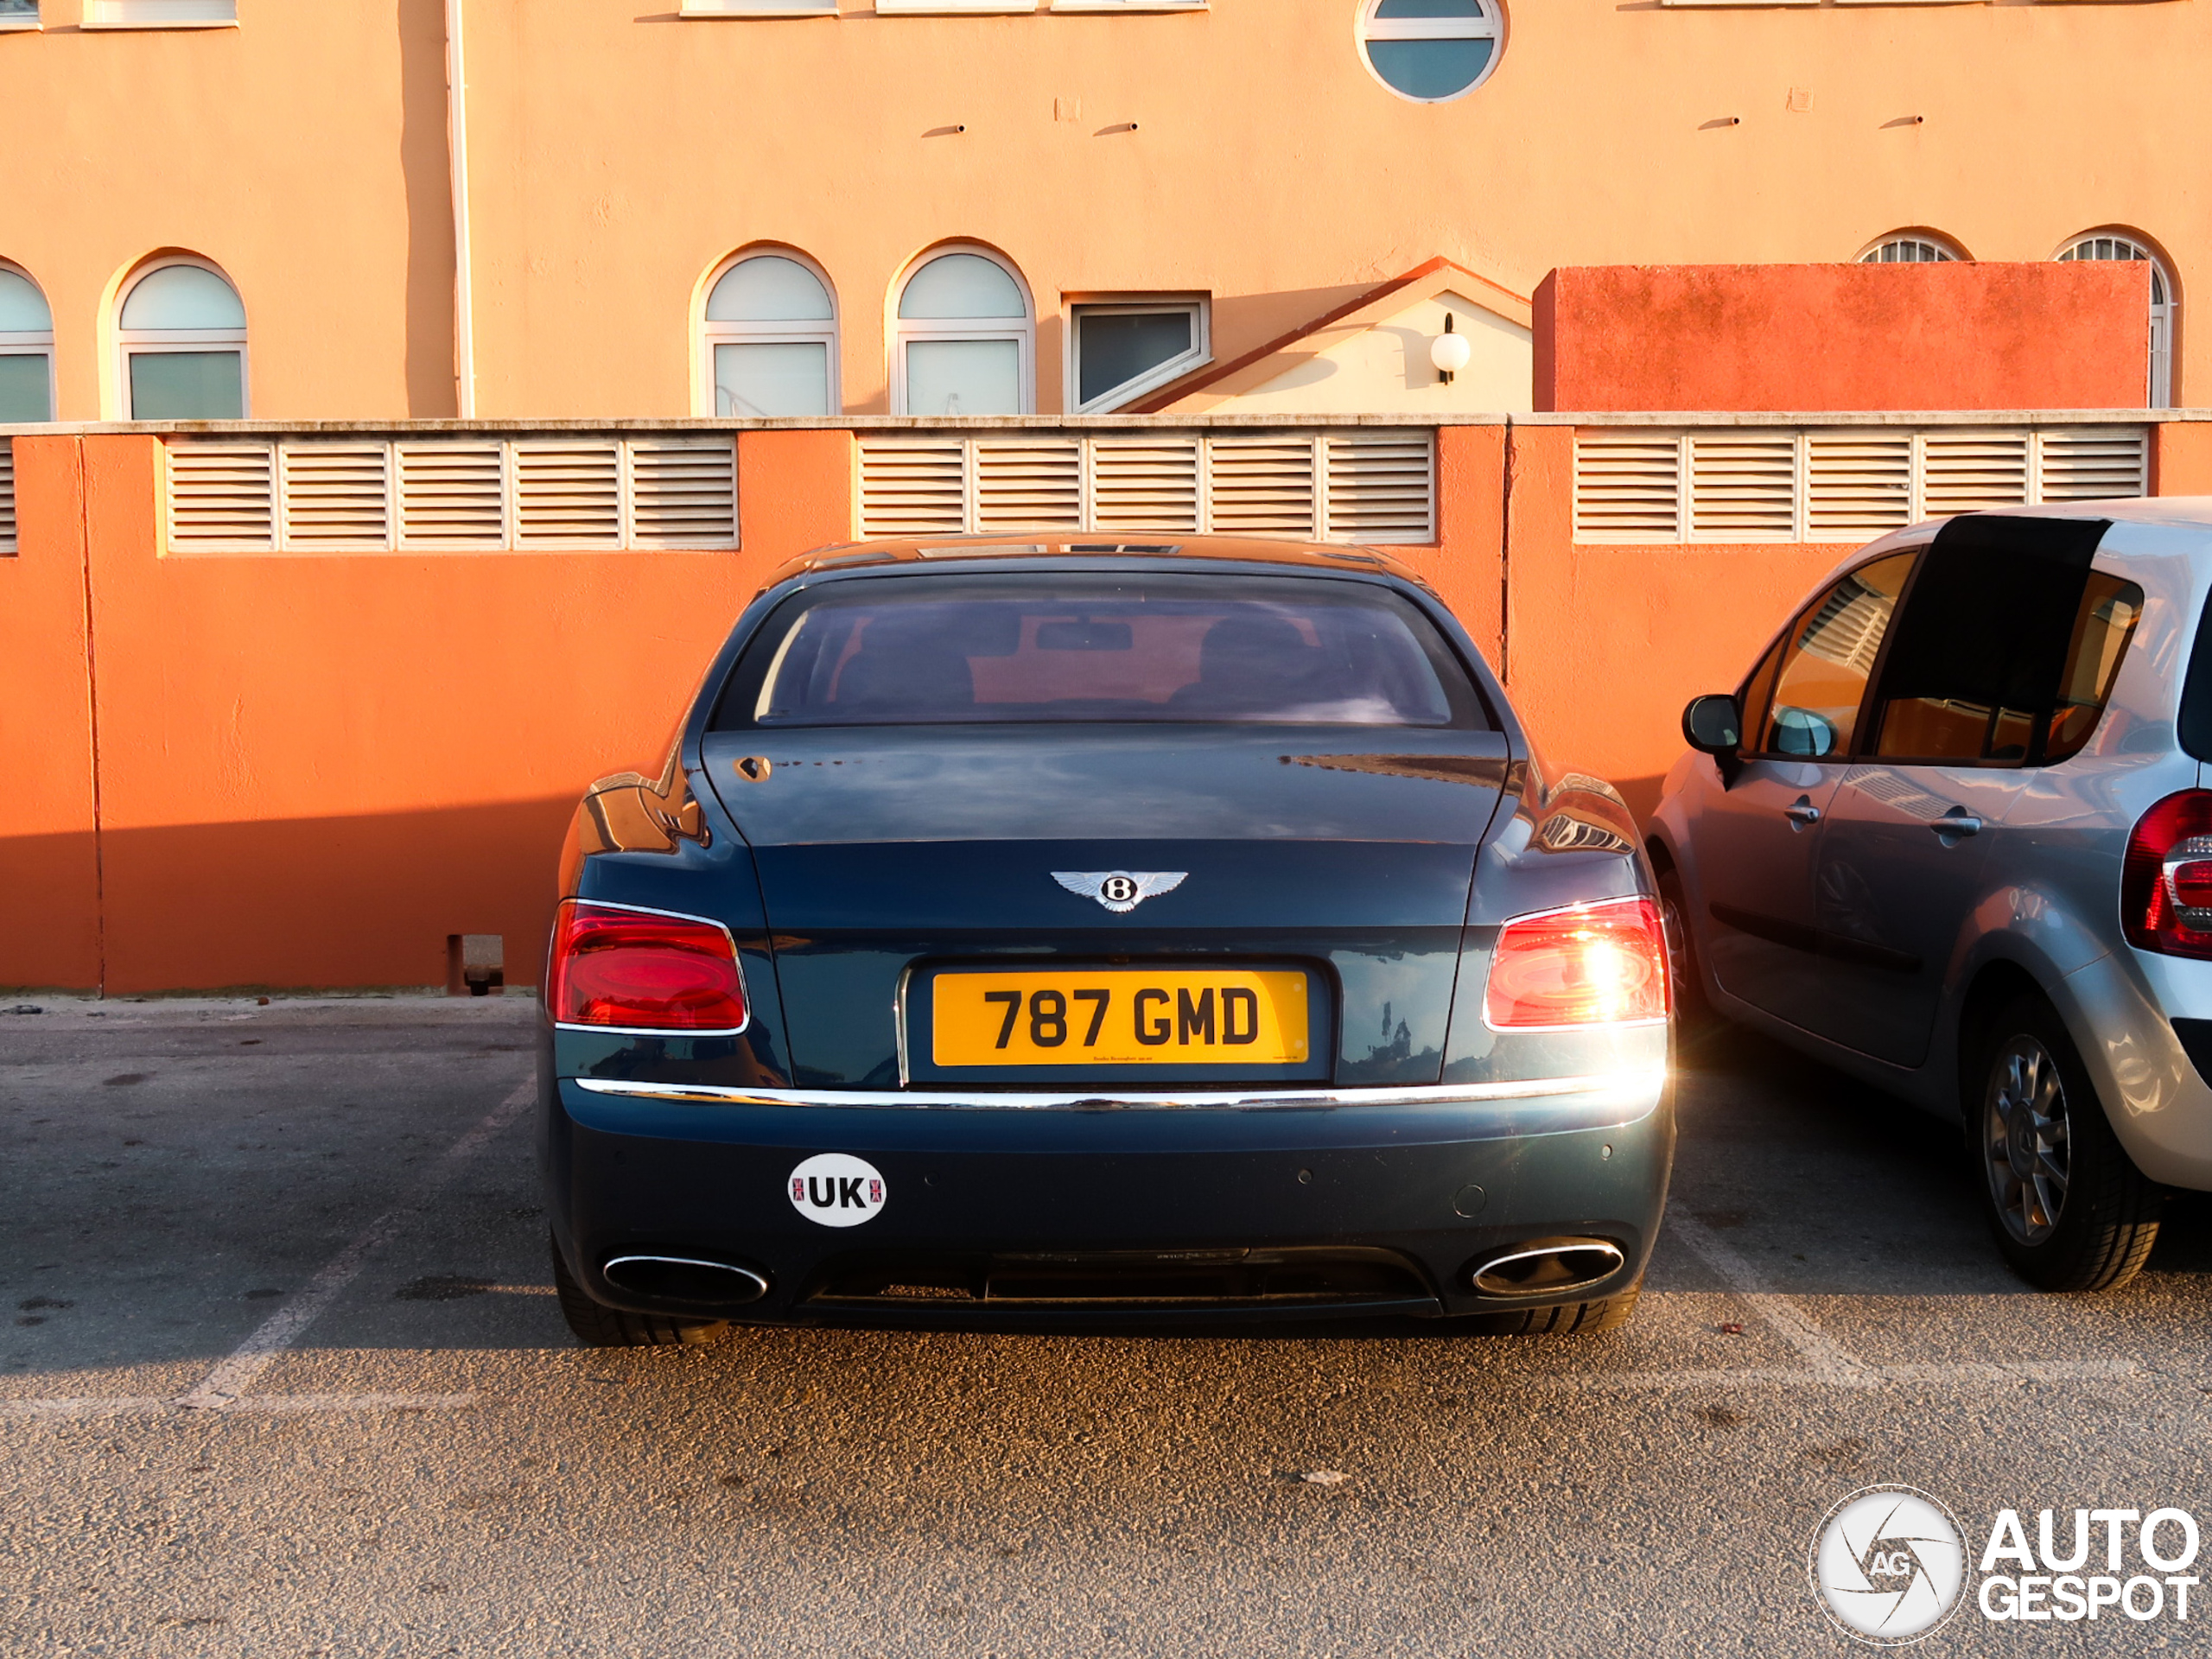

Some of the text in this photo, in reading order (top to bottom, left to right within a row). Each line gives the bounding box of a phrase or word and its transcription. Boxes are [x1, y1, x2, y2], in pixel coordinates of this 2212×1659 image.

[985, 988, 1258, 1048] 787 GMD
[808, 1177, 867, 1208] UK
